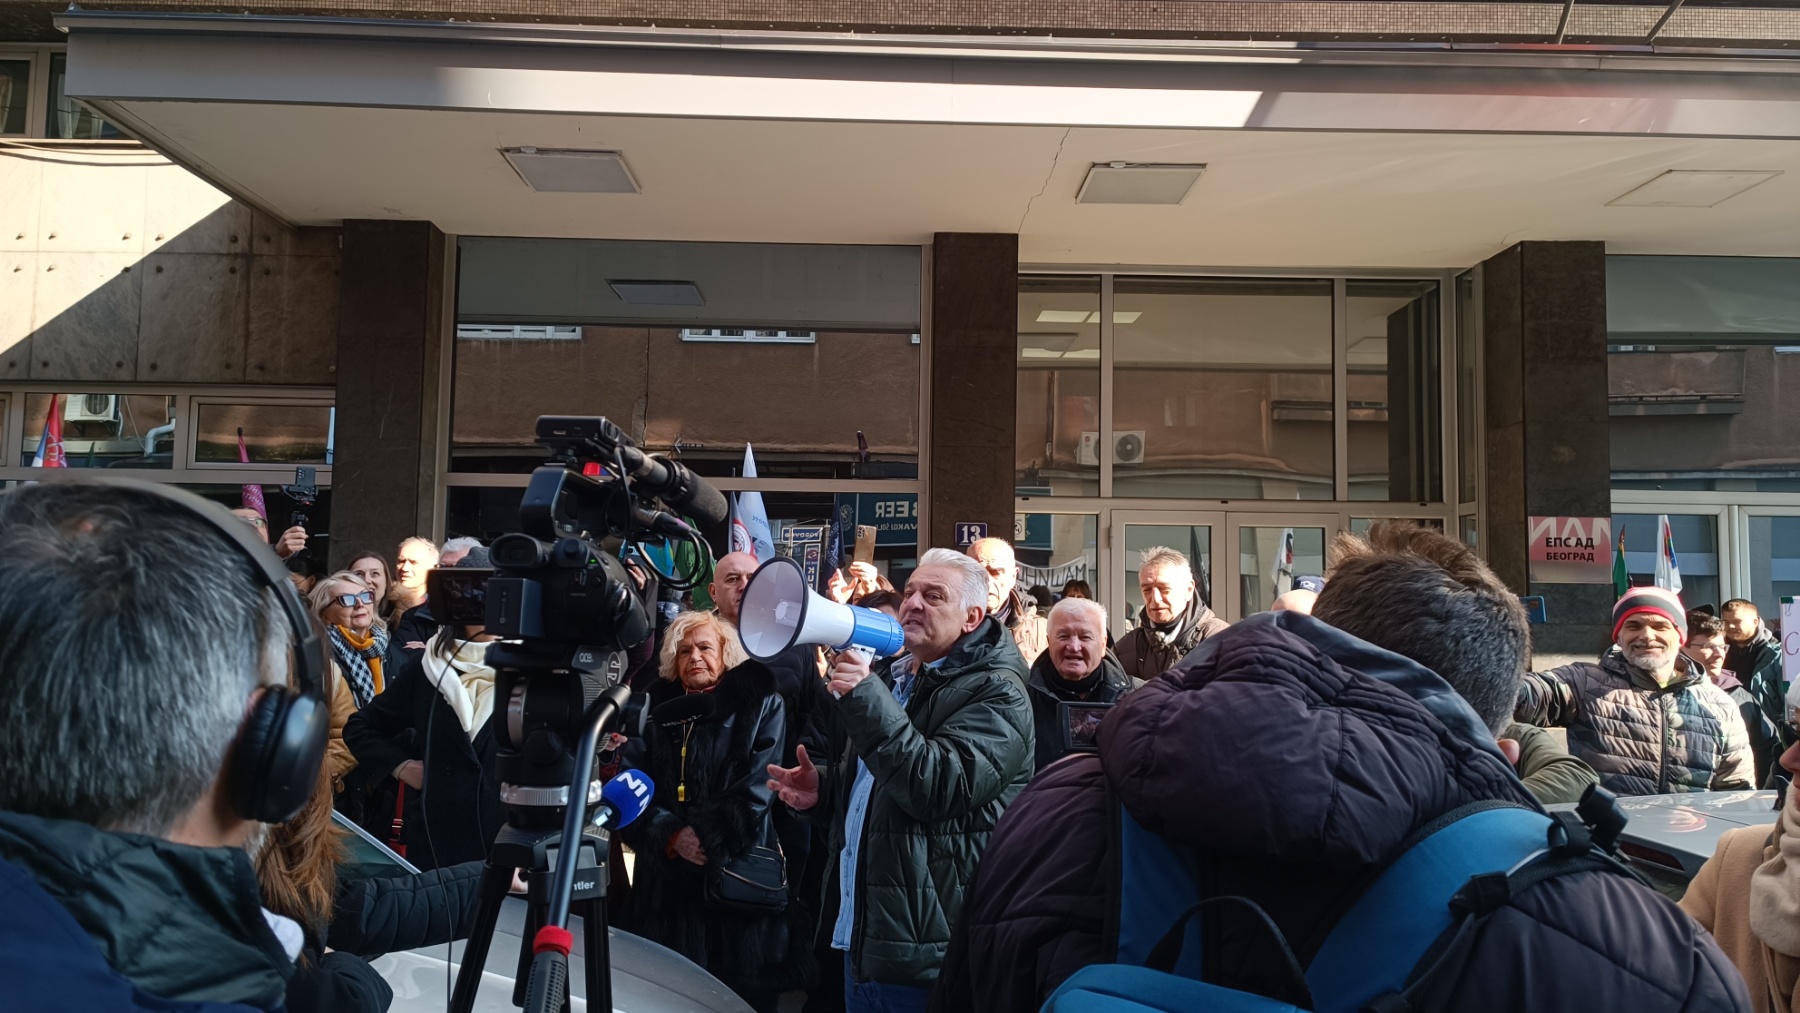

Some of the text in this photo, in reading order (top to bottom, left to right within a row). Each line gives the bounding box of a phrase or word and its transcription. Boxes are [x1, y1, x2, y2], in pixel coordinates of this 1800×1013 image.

[961, 525, 981, 543] 13
[1545, 537, 1594, 550] ЕПС АД
[1546, 552, 1594, 562] БЕОГРАД
[616, 772, 648, 798] N1
